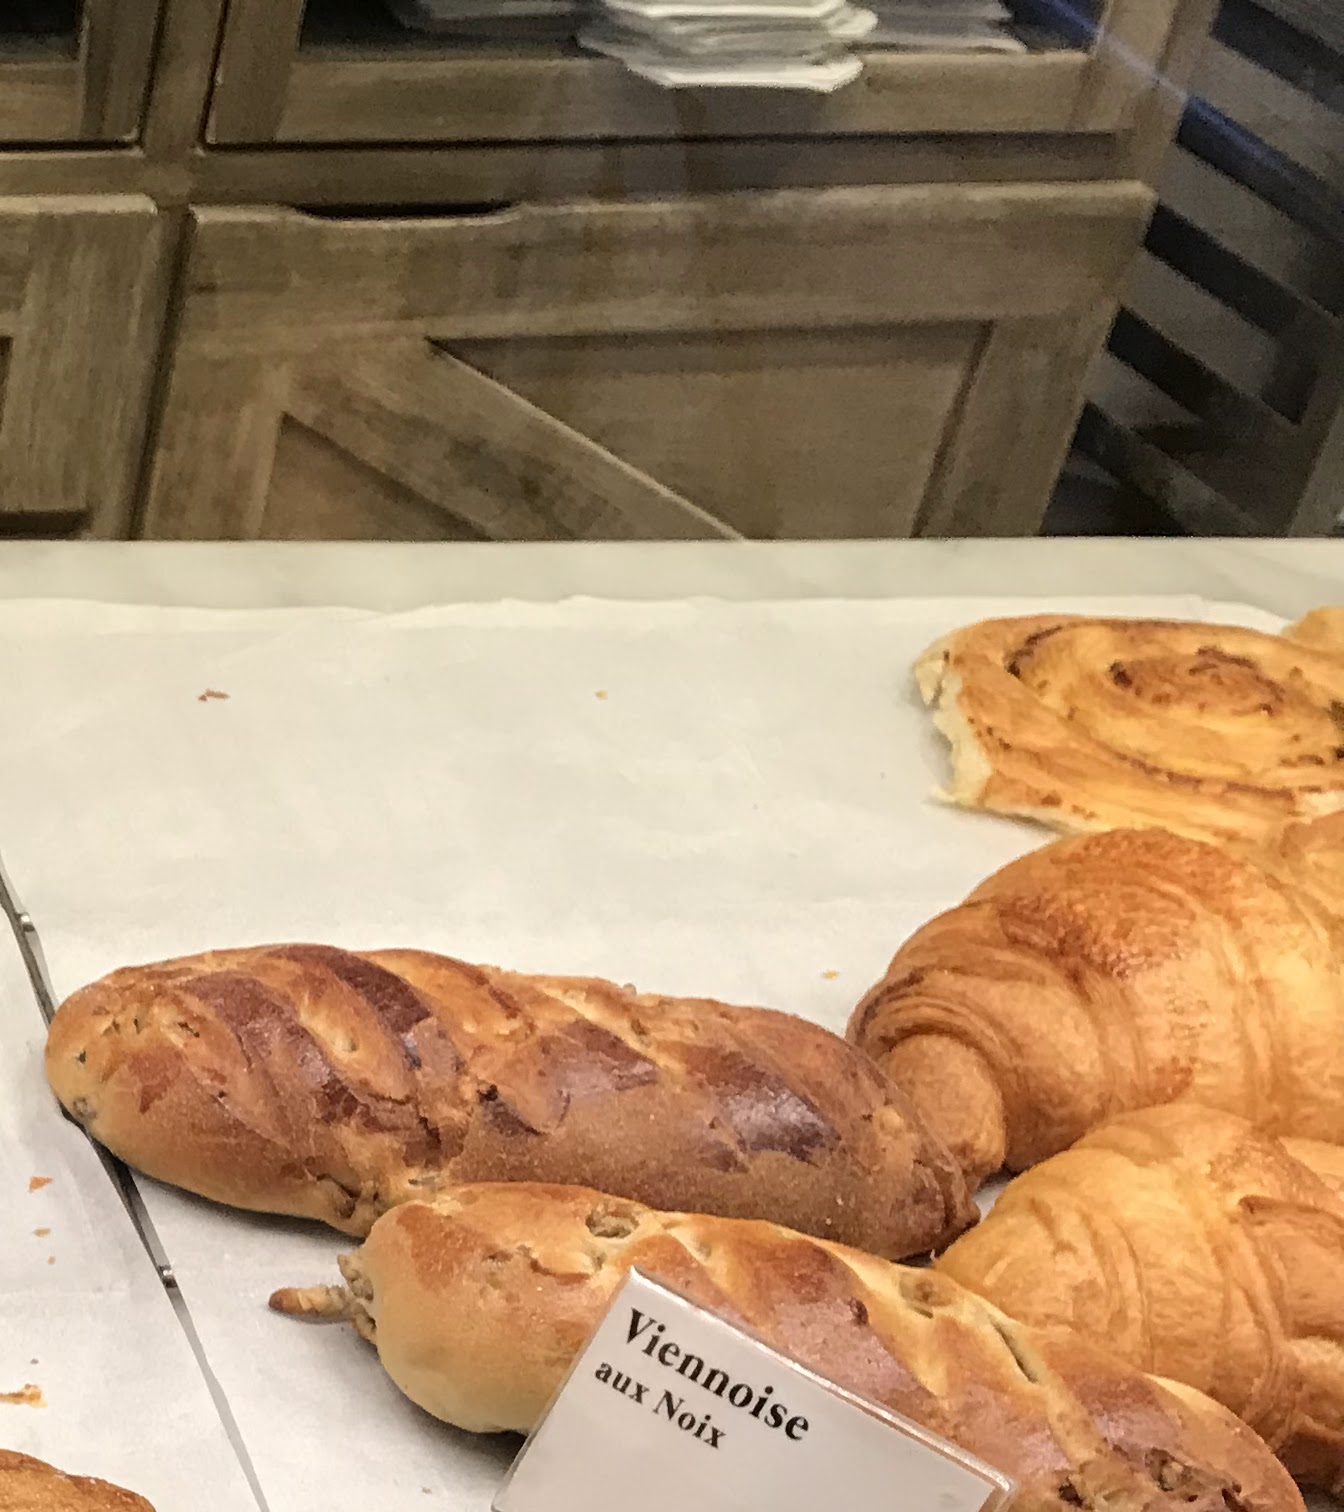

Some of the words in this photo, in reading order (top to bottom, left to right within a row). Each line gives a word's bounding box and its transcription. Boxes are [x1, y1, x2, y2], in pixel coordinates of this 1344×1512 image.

[594, 1360, 652, 1405] aux
[653, 1389, 726, 1448] Noix
[625, 1308, 810, 1441] Viennoise
